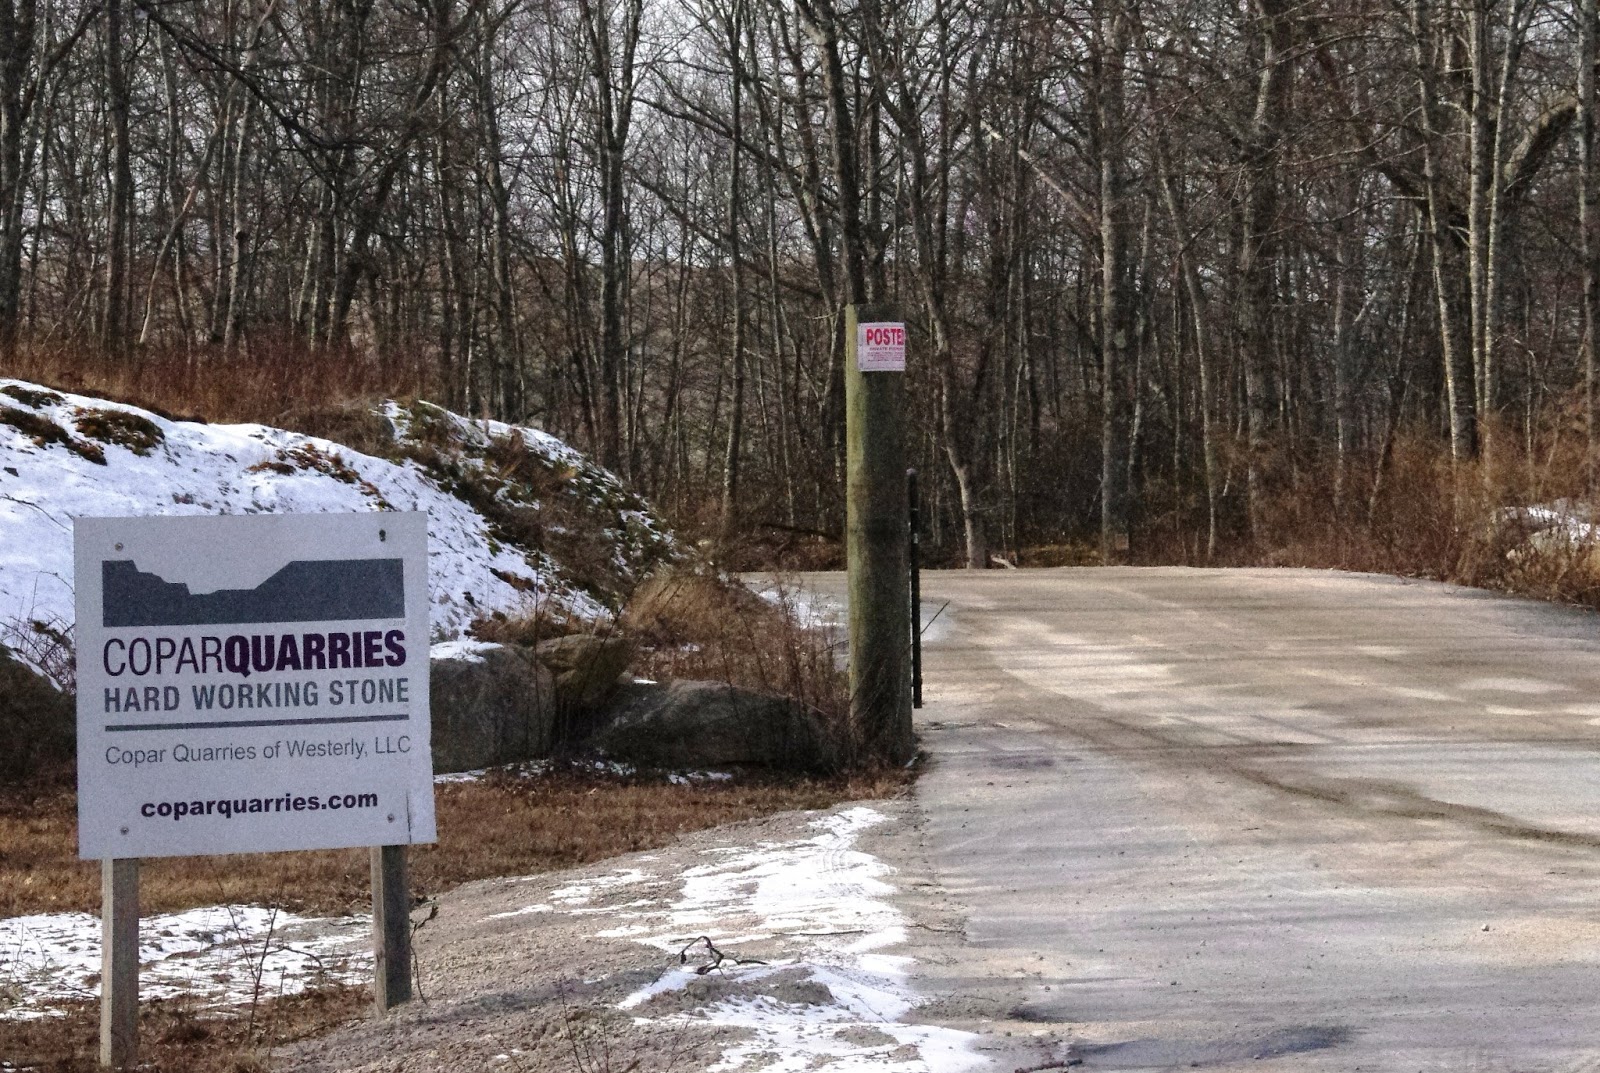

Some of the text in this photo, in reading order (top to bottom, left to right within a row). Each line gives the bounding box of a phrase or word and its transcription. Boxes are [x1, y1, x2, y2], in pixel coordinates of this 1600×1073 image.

[103, 630, 407, 678] COPARQUARRIES
[104, 677, 409, 713] HARD WORKING STONE
[105, 734, 411, 769] Copar Quarries of Westerly, LLC
[141, 792, 379, 821] coparquarries.com
